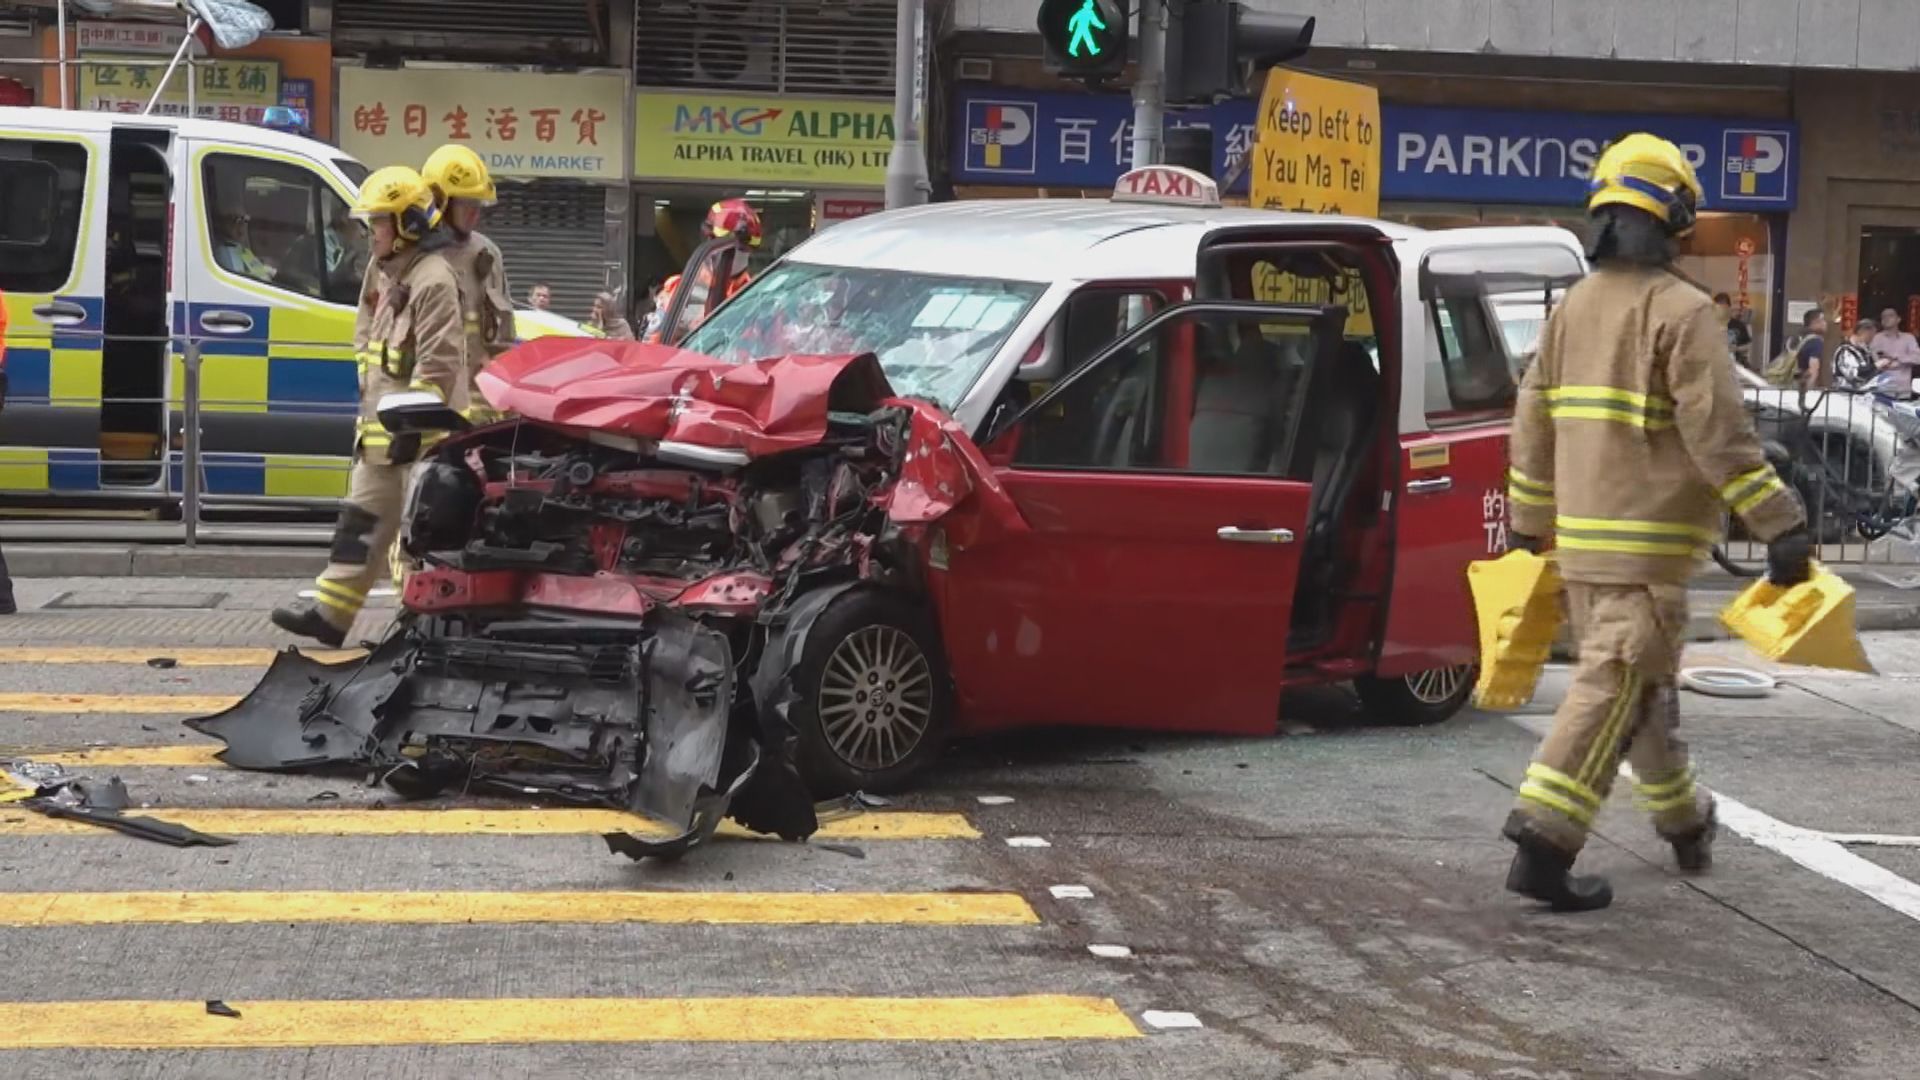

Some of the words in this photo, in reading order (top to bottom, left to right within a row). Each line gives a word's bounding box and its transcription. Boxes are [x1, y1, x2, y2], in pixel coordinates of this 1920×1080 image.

[354, 101, 606, 146] 皓日生活百貨
[787, 110, 896, 141] ALPHA
[1267, 97, 1313, 142] Keep
[1318, 105, 1350, 143] left
[1357, 113, 1373, 145] to
[491, 153, 524, 168] DAY
[530, 155, 604, 171] MARKET
[673, 143, 734, 162] ALPHA
[741, 146, 808, 166] TRAVEL
[813, 149, 855, 169] (HK)
[1263, 147, 1298, 184] Yau
[1305, 153, 1332, 188] Ma
[1340, 158, 1366, 192] Tei
[1397, 132, 1706, 180] PARKnSP
[1126, 170, 1194, 197] TAXI
